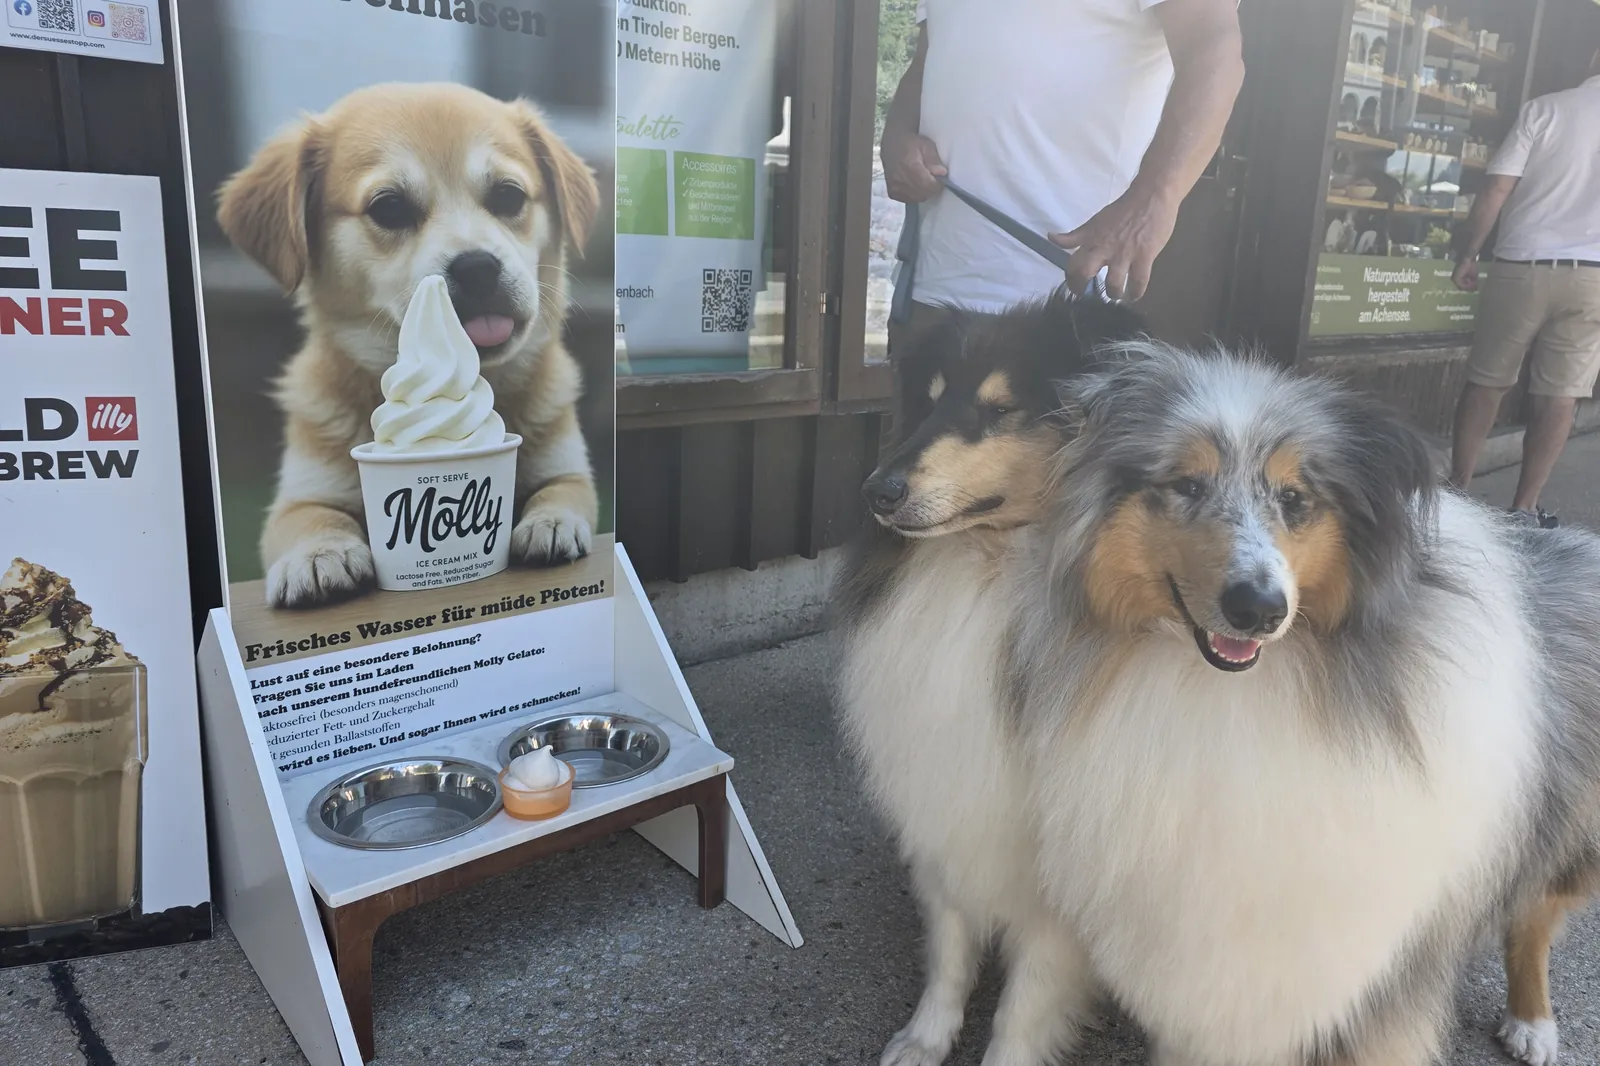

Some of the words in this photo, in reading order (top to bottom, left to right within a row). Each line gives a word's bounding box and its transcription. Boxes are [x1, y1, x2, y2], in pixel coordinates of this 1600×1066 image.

[9, 31, 105, 49] www.dersuessestopp.com
[632, 15, 680, 40] Tiroler
[682, 25, 740, 49] Bergen.
[625, 42, 679, 66] Metern
[681, 50, 721, 72] Höhe
[682, 156, 737, 175] Accessoires
[616, 285, 654, 298] enbach
[1363, 266, 1420, 285] Naturprodukte
[1368, 287, 1410, 305] hergestellt
[0, 296, 131, 336] NER
[1358, 311, 1372, 323] am
[1372, 307, 1411, 323] Achensee.
[91, 402, 133, 435] illy
[0, 449, 139, 481] BREW
[417, 475, 440, 484] SOFT
[442, 472, 469, 483] SERVE
[383, 476, 503, 555] Molly
[396, 572, 424, 581] Lactose
[425, 570, 442, 578] Free.
[443, 564, 474, 575] Reduced
[474, 559, 495, 570] Sugar
[416, 559, 430, 568] ICE
[432, 555, 461, 567] CREAM
[463, 551, 478, 561] MIX
[412, 579, 427, 588] and
[427, 577, 444, 586] Fats.
[445, 573, 462, 583] With
[462, 570, 481, 580] Fiber.
[245, 631, 351, 662] Frisches
[356, 612, 437, 640] Wasser
[441, 605, 476, 624] für
[480, 594, 536, 617] müde
[540, 579, 605, 605] Pfoten!
[250, 675, 283, 691] Lust
[286, 669, 310, 682] auf
[312, 663, 341, 677] eine
[344, 649, 409, 670] besondere
[412, 633, 482, 656] Belohnung?
[252, 688, 302, 704] Fragen
[304, 682, 326, 693] Sie
[329, 677, 353, 688] uns
[356, 671, 373, 682] im
[376, 663, 414, 677] Laden
[291, 690, 350, 711] unserem
[353, 663, 472, 697] hundefreundlichen
[473, 656, 504, 670] Molly
[507, 647, 546, 662] Gelato:
[320, 700, 376, 720] (besonders
[378, 678, 459, 705] magenschonend)
[323, 721, 347, 733] Fett-
[349, 714, 370, 727] und
[371, 697, 435, 721] Zuckergehalt
[278, 756, 313, 772] wird
[316, 753, 330, 763] es
[333, 742, 377, 759] lieben.
[379, 733, 405, 746] Und
[408, 724, 441, 739] sogar
[443, 715, 477, 730] Ihnen
[479, 706, 506, 719] wird
[509, 704, 520, 713] es
[522, 686, 581, 709] schmecken!
[279, 739, 331, 760] gesunden
[334, 721, 401, 745] Ballaststoffen
